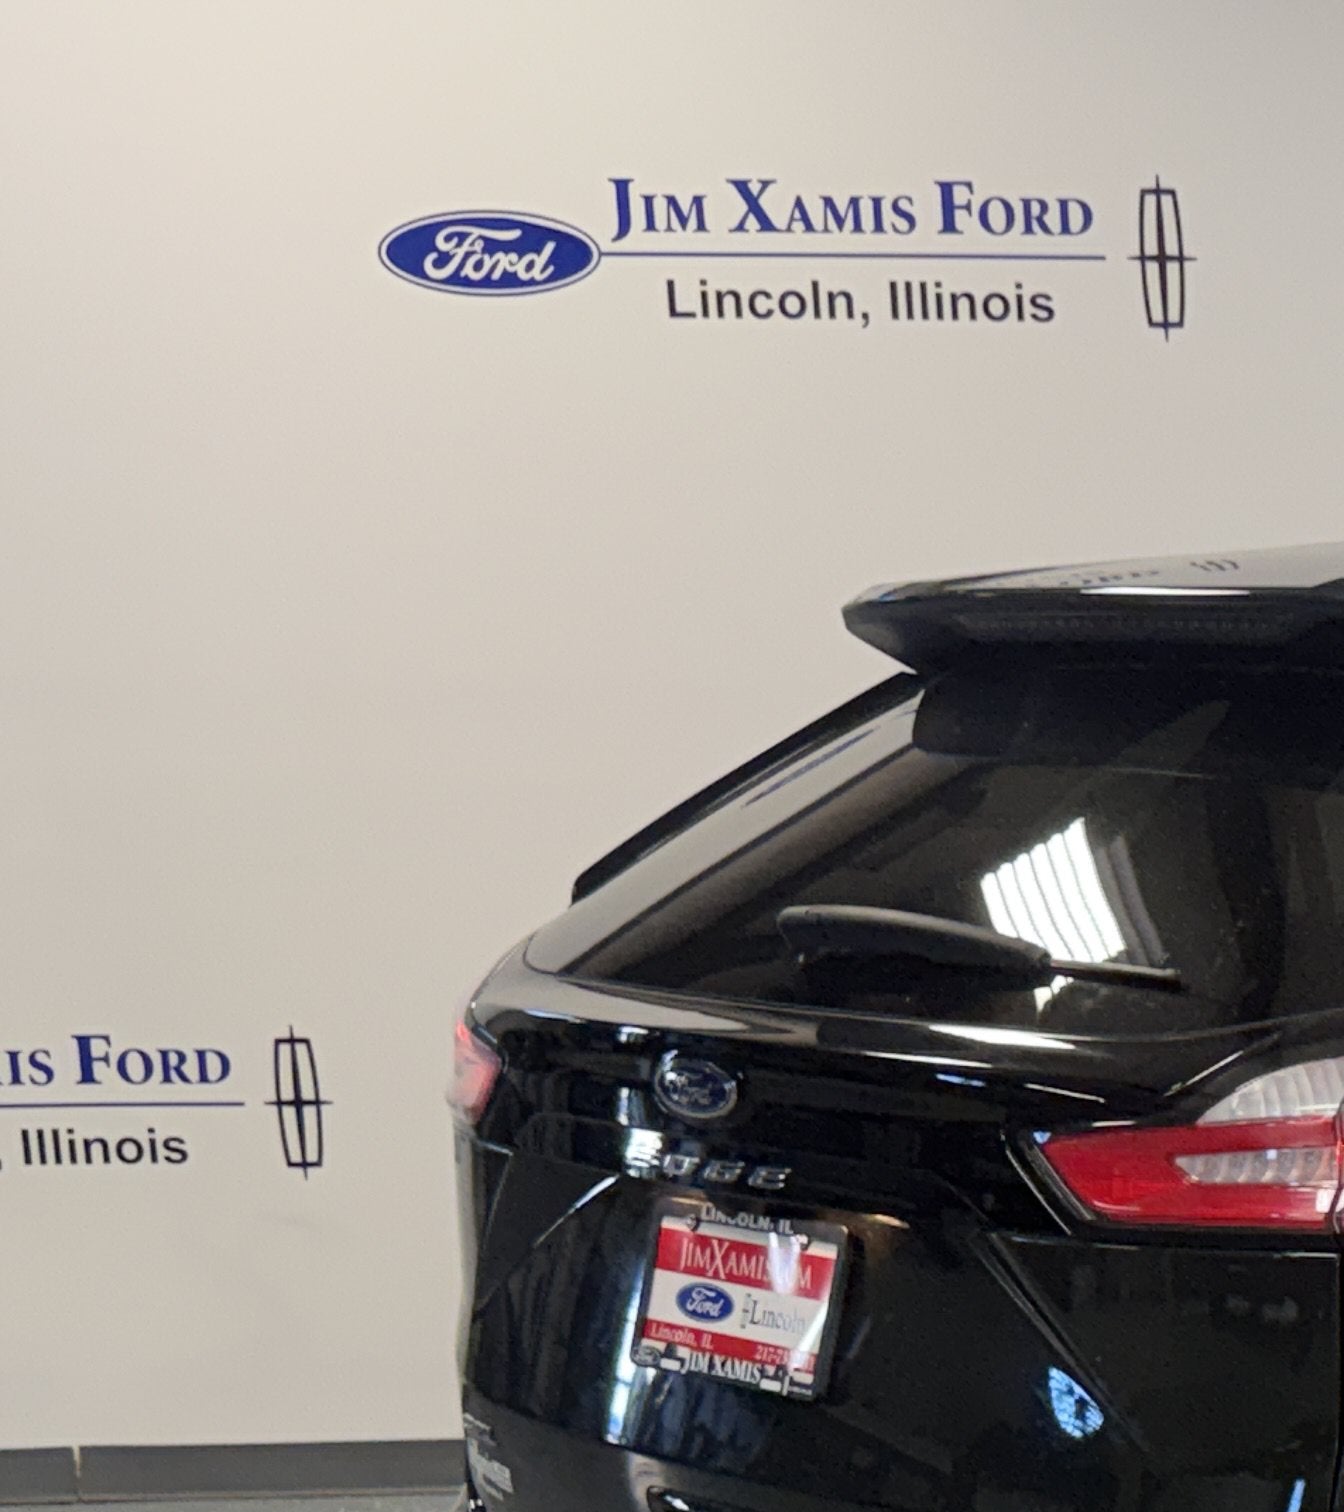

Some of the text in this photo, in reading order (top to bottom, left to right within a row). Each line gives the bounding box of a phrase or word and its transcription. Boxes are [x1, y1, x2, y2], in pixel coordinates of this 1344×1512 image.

[608, 178, 1095, 243] JIM XAMIS FORD
[422, 225, 556, 285] Ford
[666, 279, 1056, 328] Lincoln, Illinois
[71, 1034, 232, 1085] FORD
[21, 1128, 189, 1166] Illinois
[685, 1286, 725, 1318] Ford
